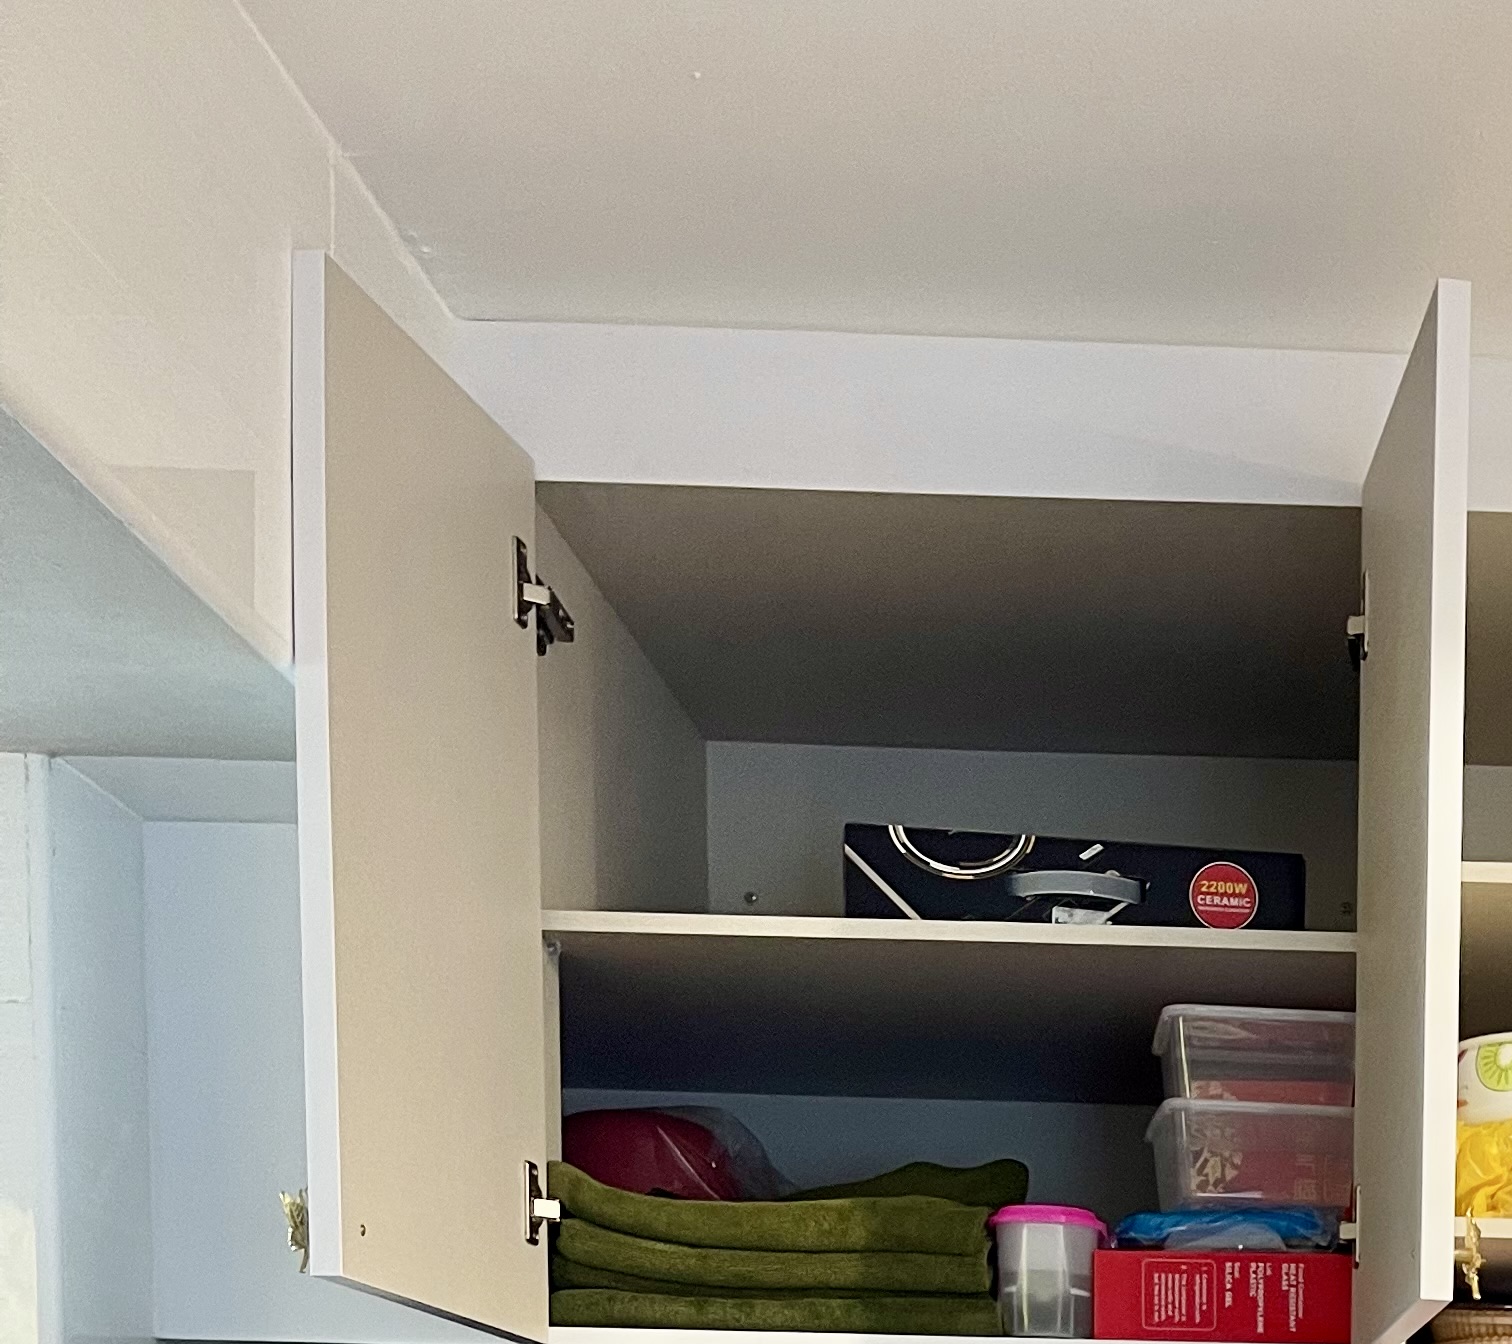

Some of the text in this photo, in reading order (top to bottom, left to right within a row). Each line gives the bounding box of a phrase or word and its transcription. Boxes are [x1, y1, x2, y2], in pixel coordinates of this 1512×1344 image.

[1200, 881, 1248, 894] 2200W
[1197, 895, 1251, 907] CERAMIC
[1249, 1262, 1257, 1297] PLASTIC
[1281, 1263, 1289, 1290] GLASS
[1289, 1263, 1297, 1285] HEAT
